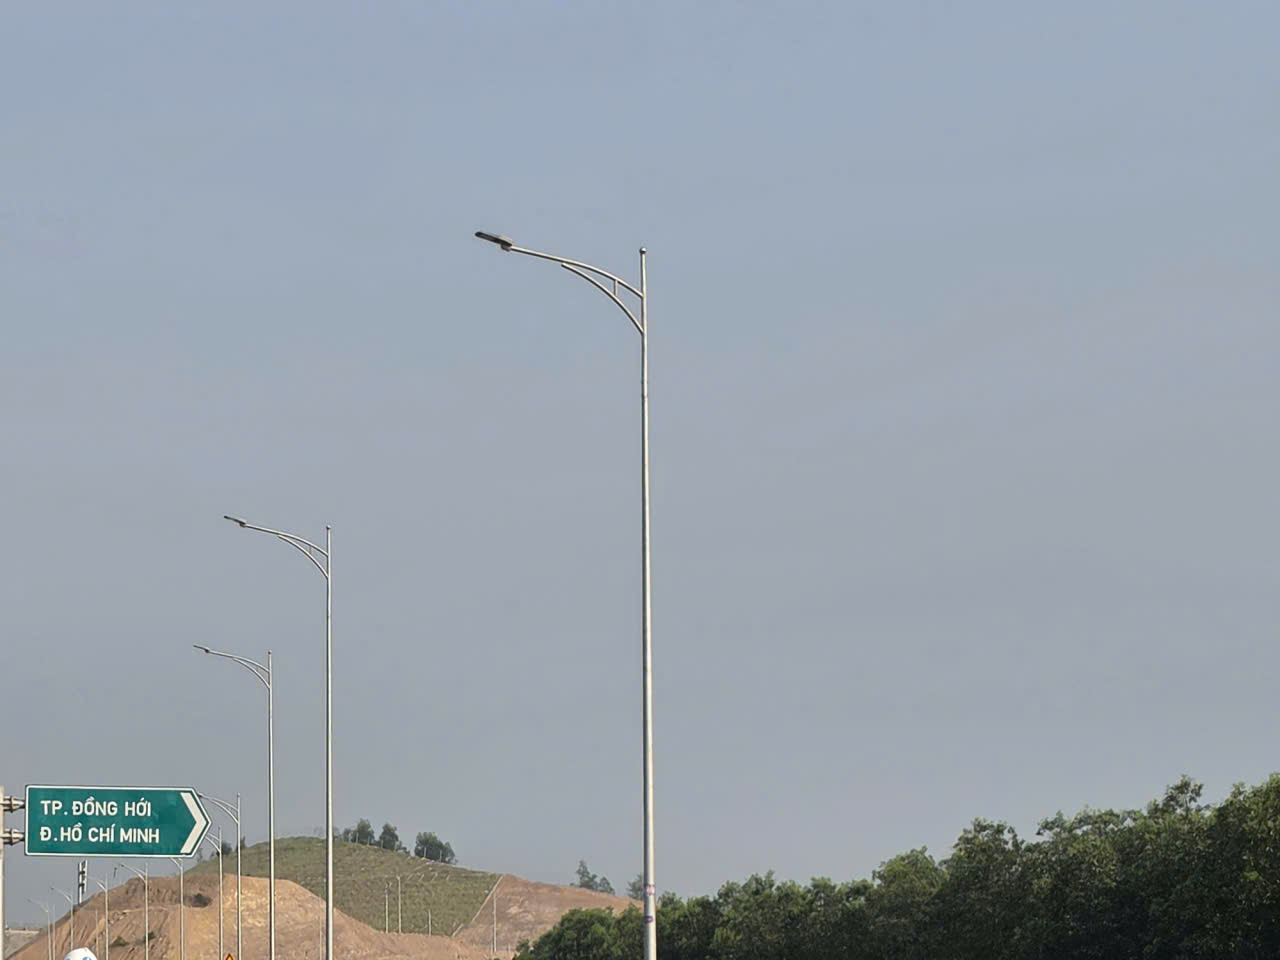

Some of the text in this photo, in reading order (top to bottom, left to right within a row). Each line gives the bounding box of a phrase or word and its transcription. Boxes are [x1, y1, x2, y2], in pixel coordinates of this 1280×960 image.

[40, 796, 152, 817] TP. ĐỒNG HỚI
[88, 823, 116, 843] CHÍ
[119, 827, 160, 843] MINH
